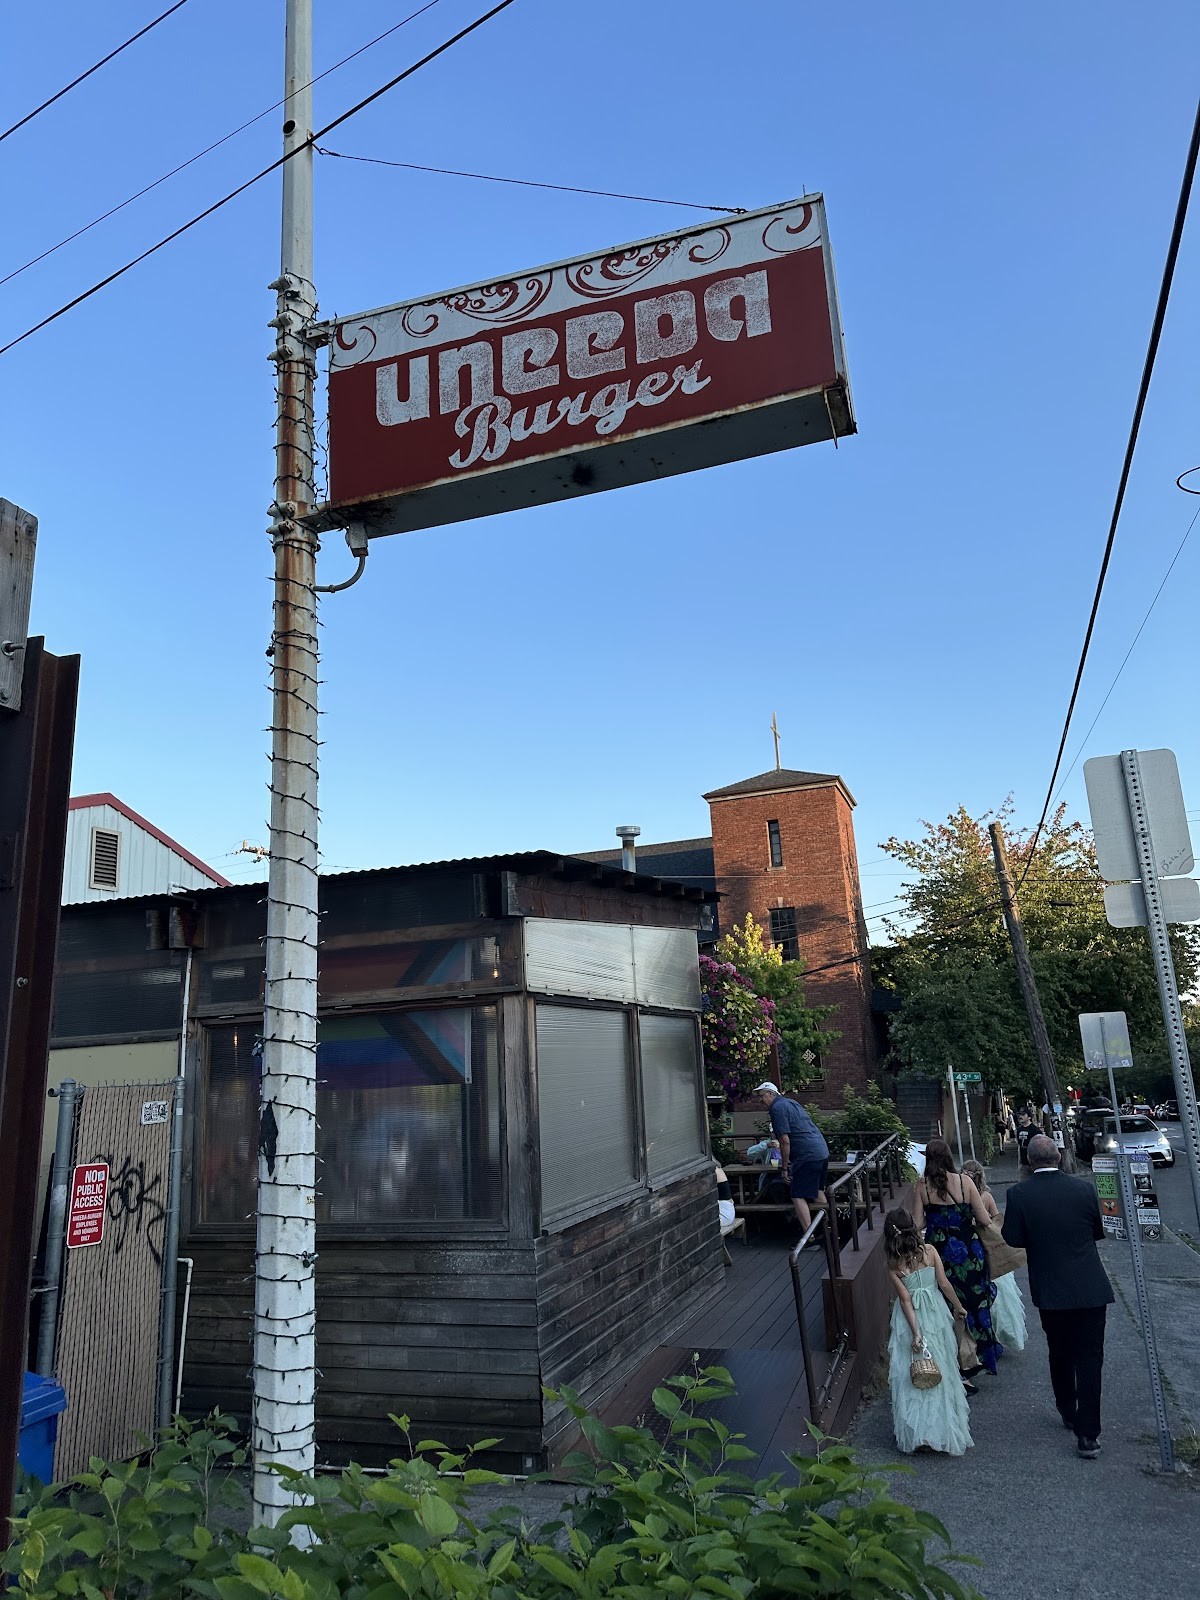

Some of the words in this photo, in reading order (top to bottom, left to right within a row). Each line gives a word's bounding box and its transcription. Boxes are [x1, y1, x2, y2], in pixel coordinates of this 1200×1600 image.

[448, 359, 711, 468] Burger
[84, 1169, 98, 1183] NO
[76, 1183, 104, 1197] PUBLIC
[73, 1195, 104, 1209] ACCESS
